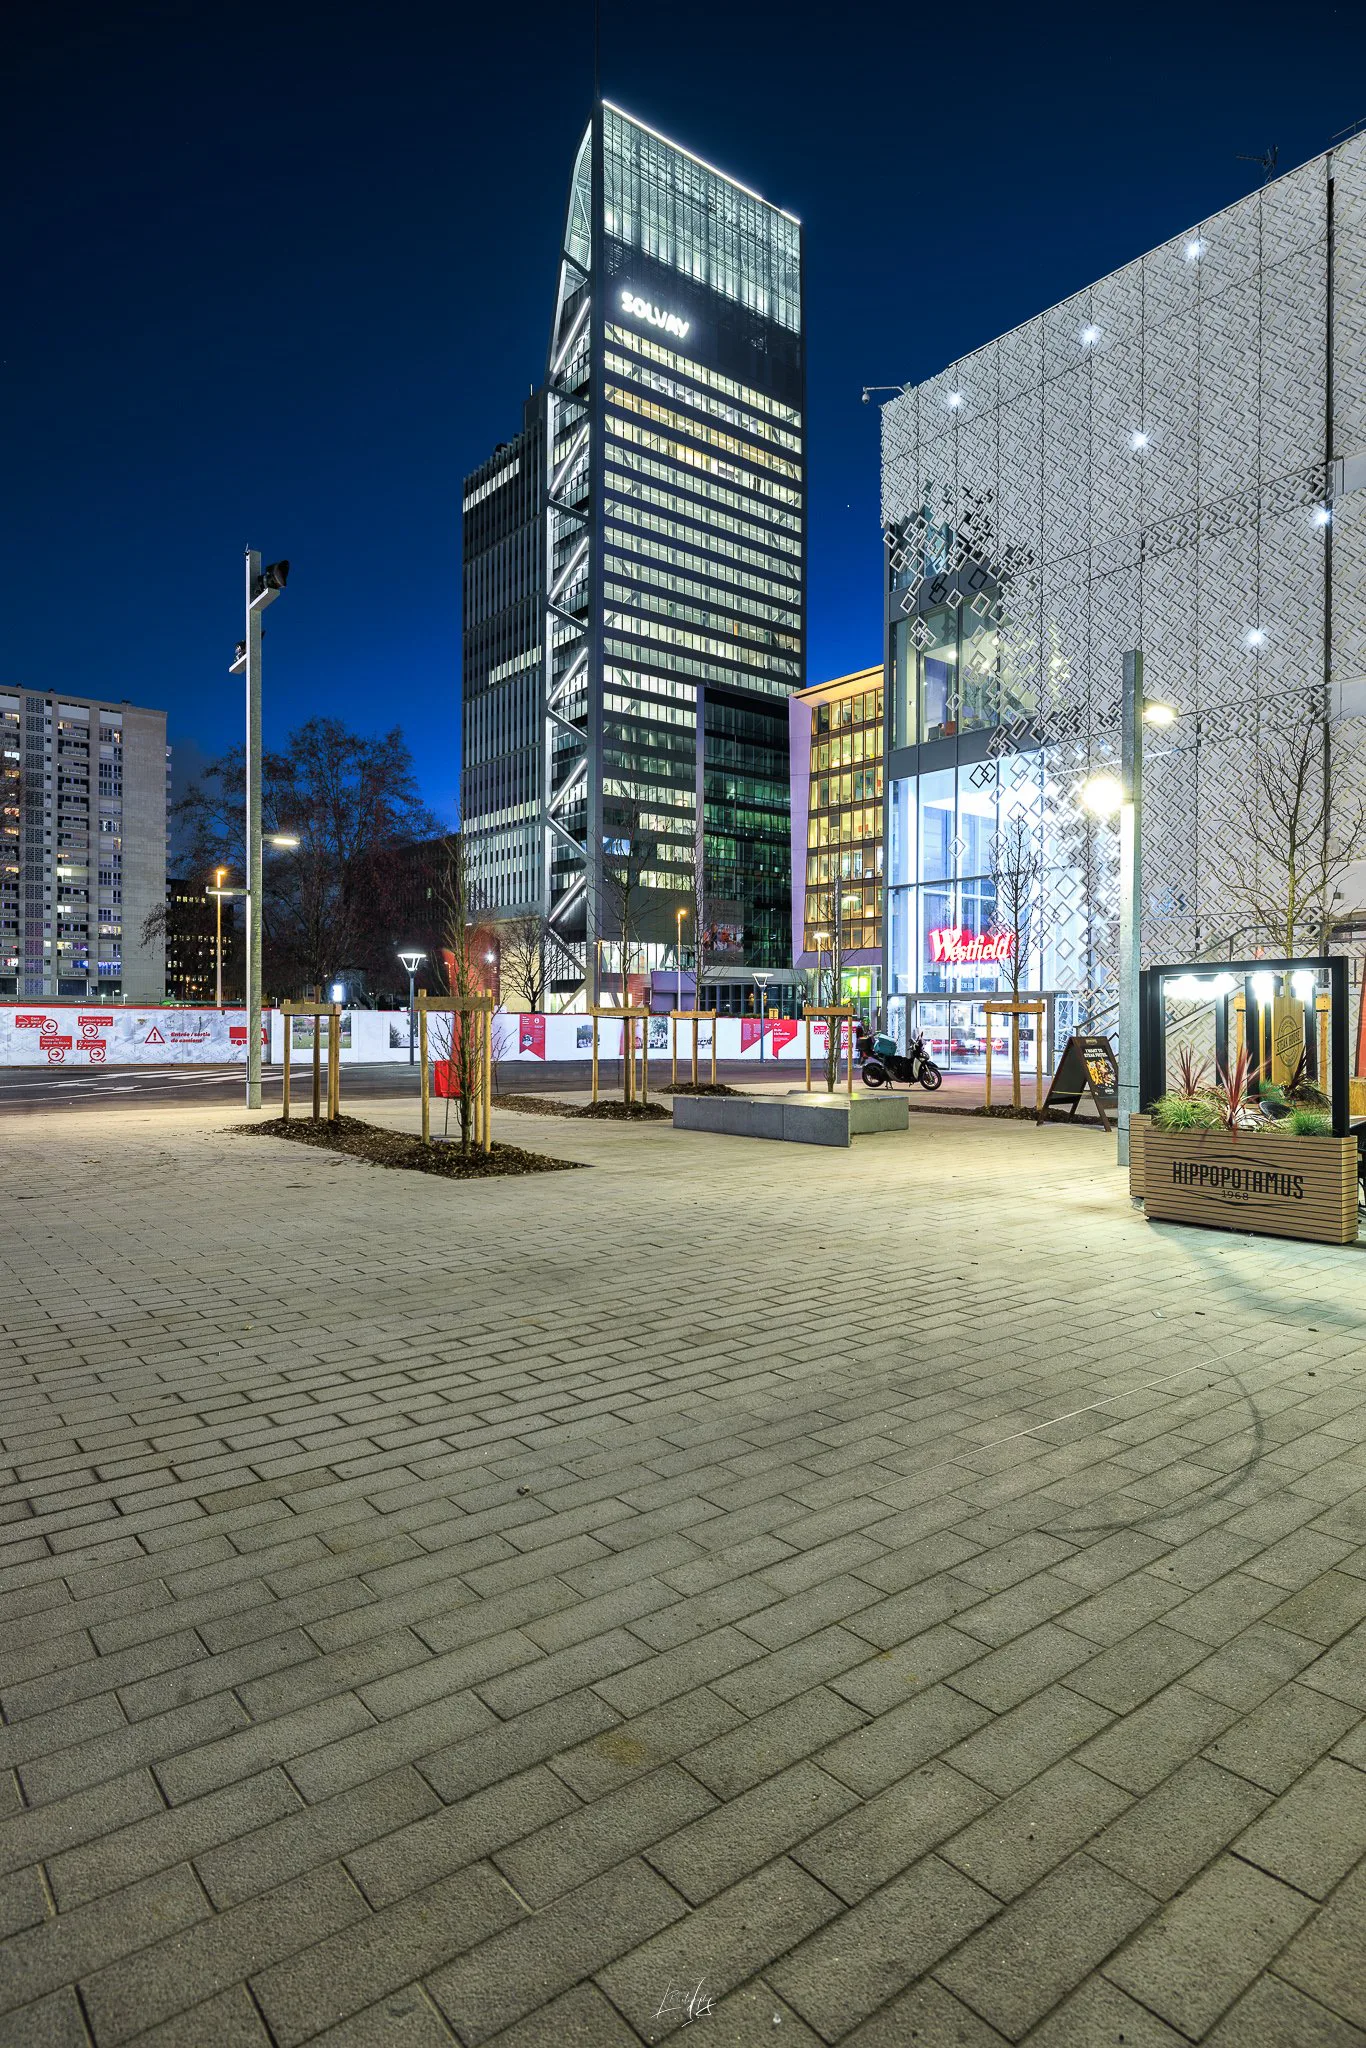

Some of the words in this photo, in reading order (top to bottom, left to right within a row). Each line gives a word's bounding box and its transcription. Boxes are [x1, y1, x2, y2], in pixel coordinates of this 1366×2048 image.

[621, 291, 689, 338] SOLVAY
[929, 928, 1014, 962] Westfield
[1173, 1161, 1304, 1199] HIPPOPOTAMUS
[1221, 1190, 1249, 1200] 1968
